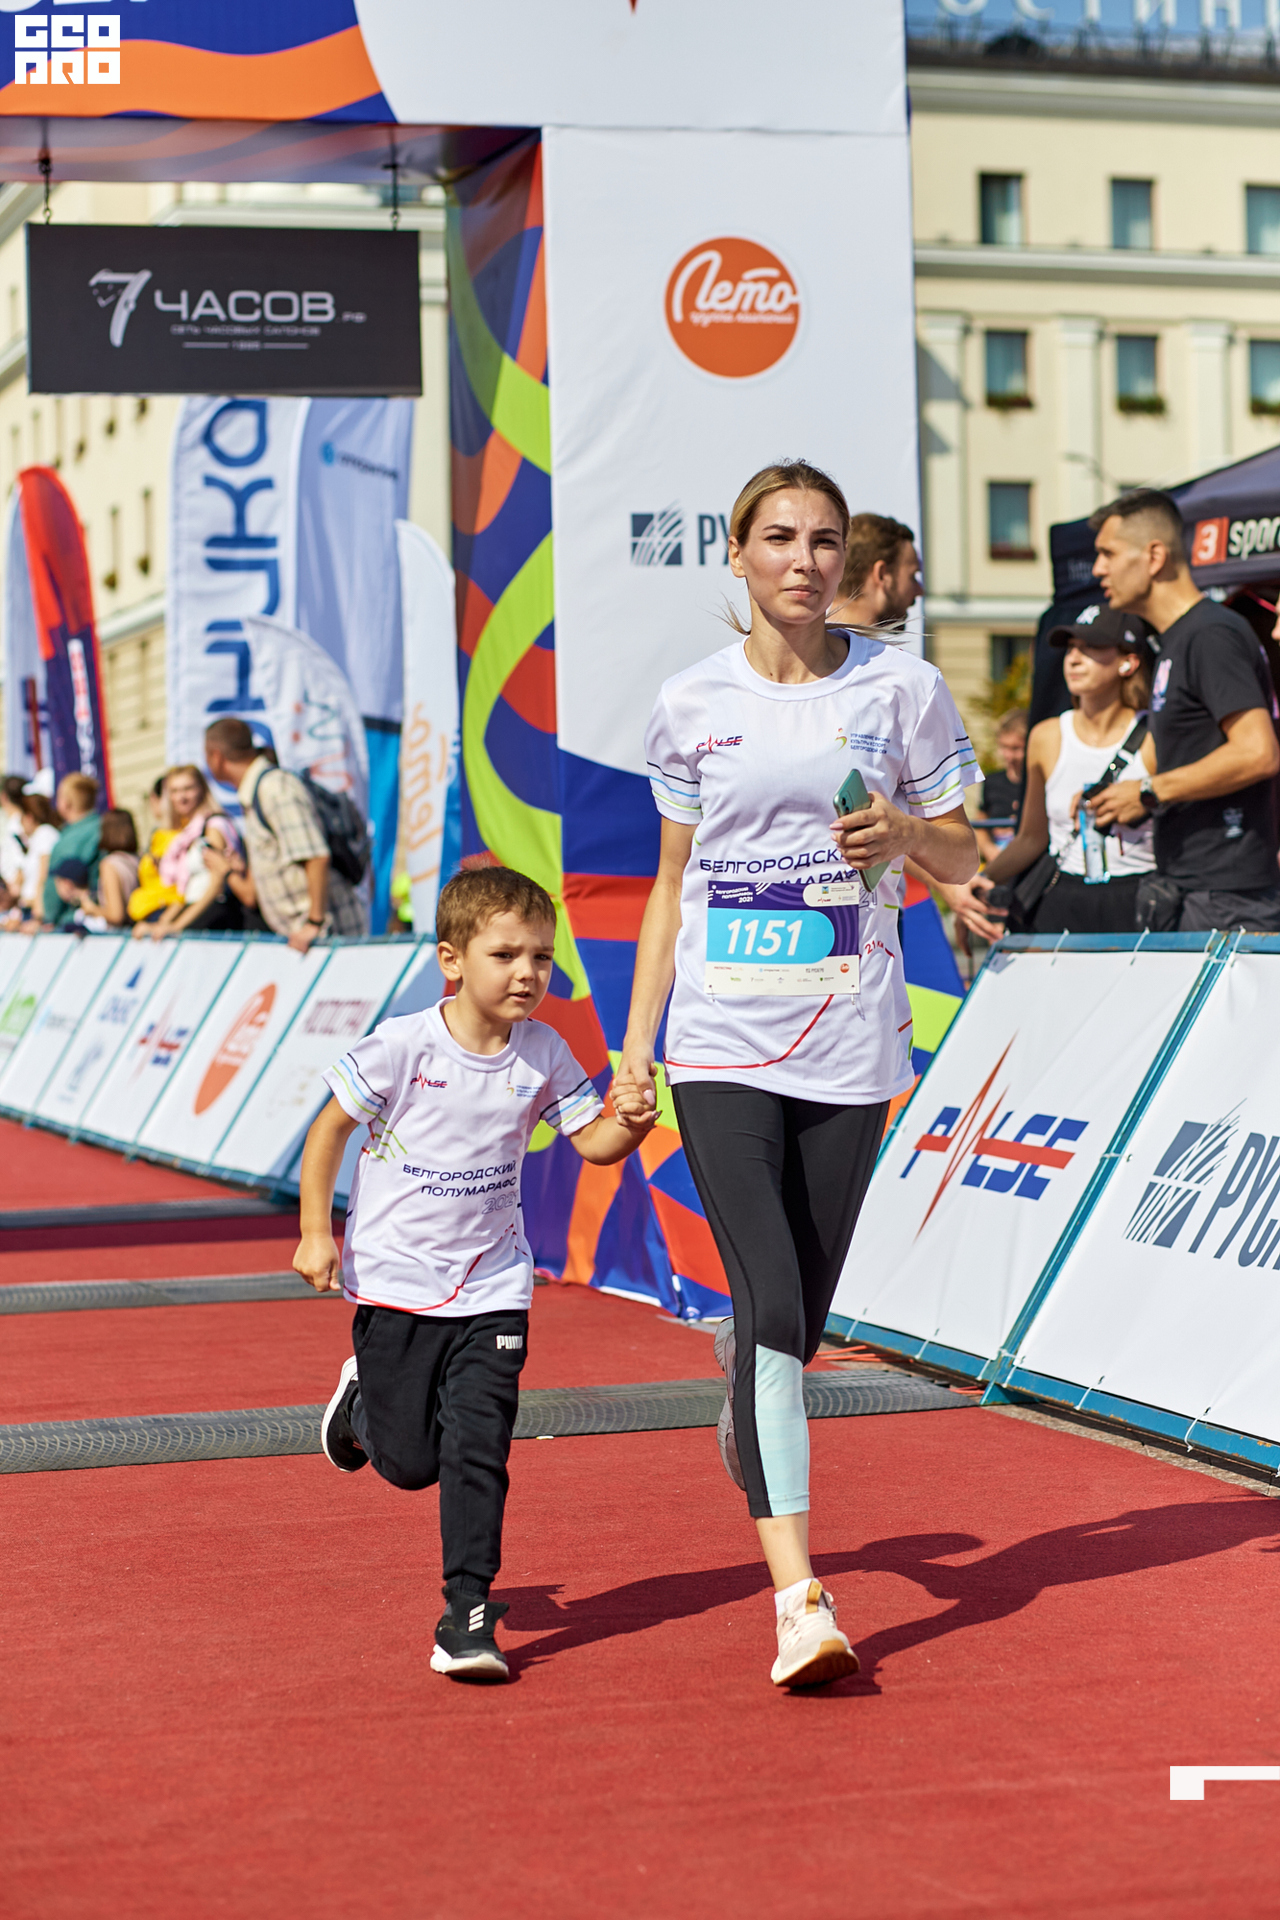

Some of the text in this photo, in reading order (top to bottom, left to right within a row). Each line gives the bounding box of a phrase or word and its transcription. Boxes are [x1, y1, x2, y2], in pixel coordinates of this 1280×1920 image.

[671, 249, 801, 323] Лето
[154, 289, 336, 323] ЧАСОВ
[1228, 516, 1280, 561] spor
[700, 848, 845, 874] БЕЛГОРОДСК
[727, 918, 803, 956] 1151
[402, 1160, 517, 1181] БЕЛГОРОДСКИЙ
